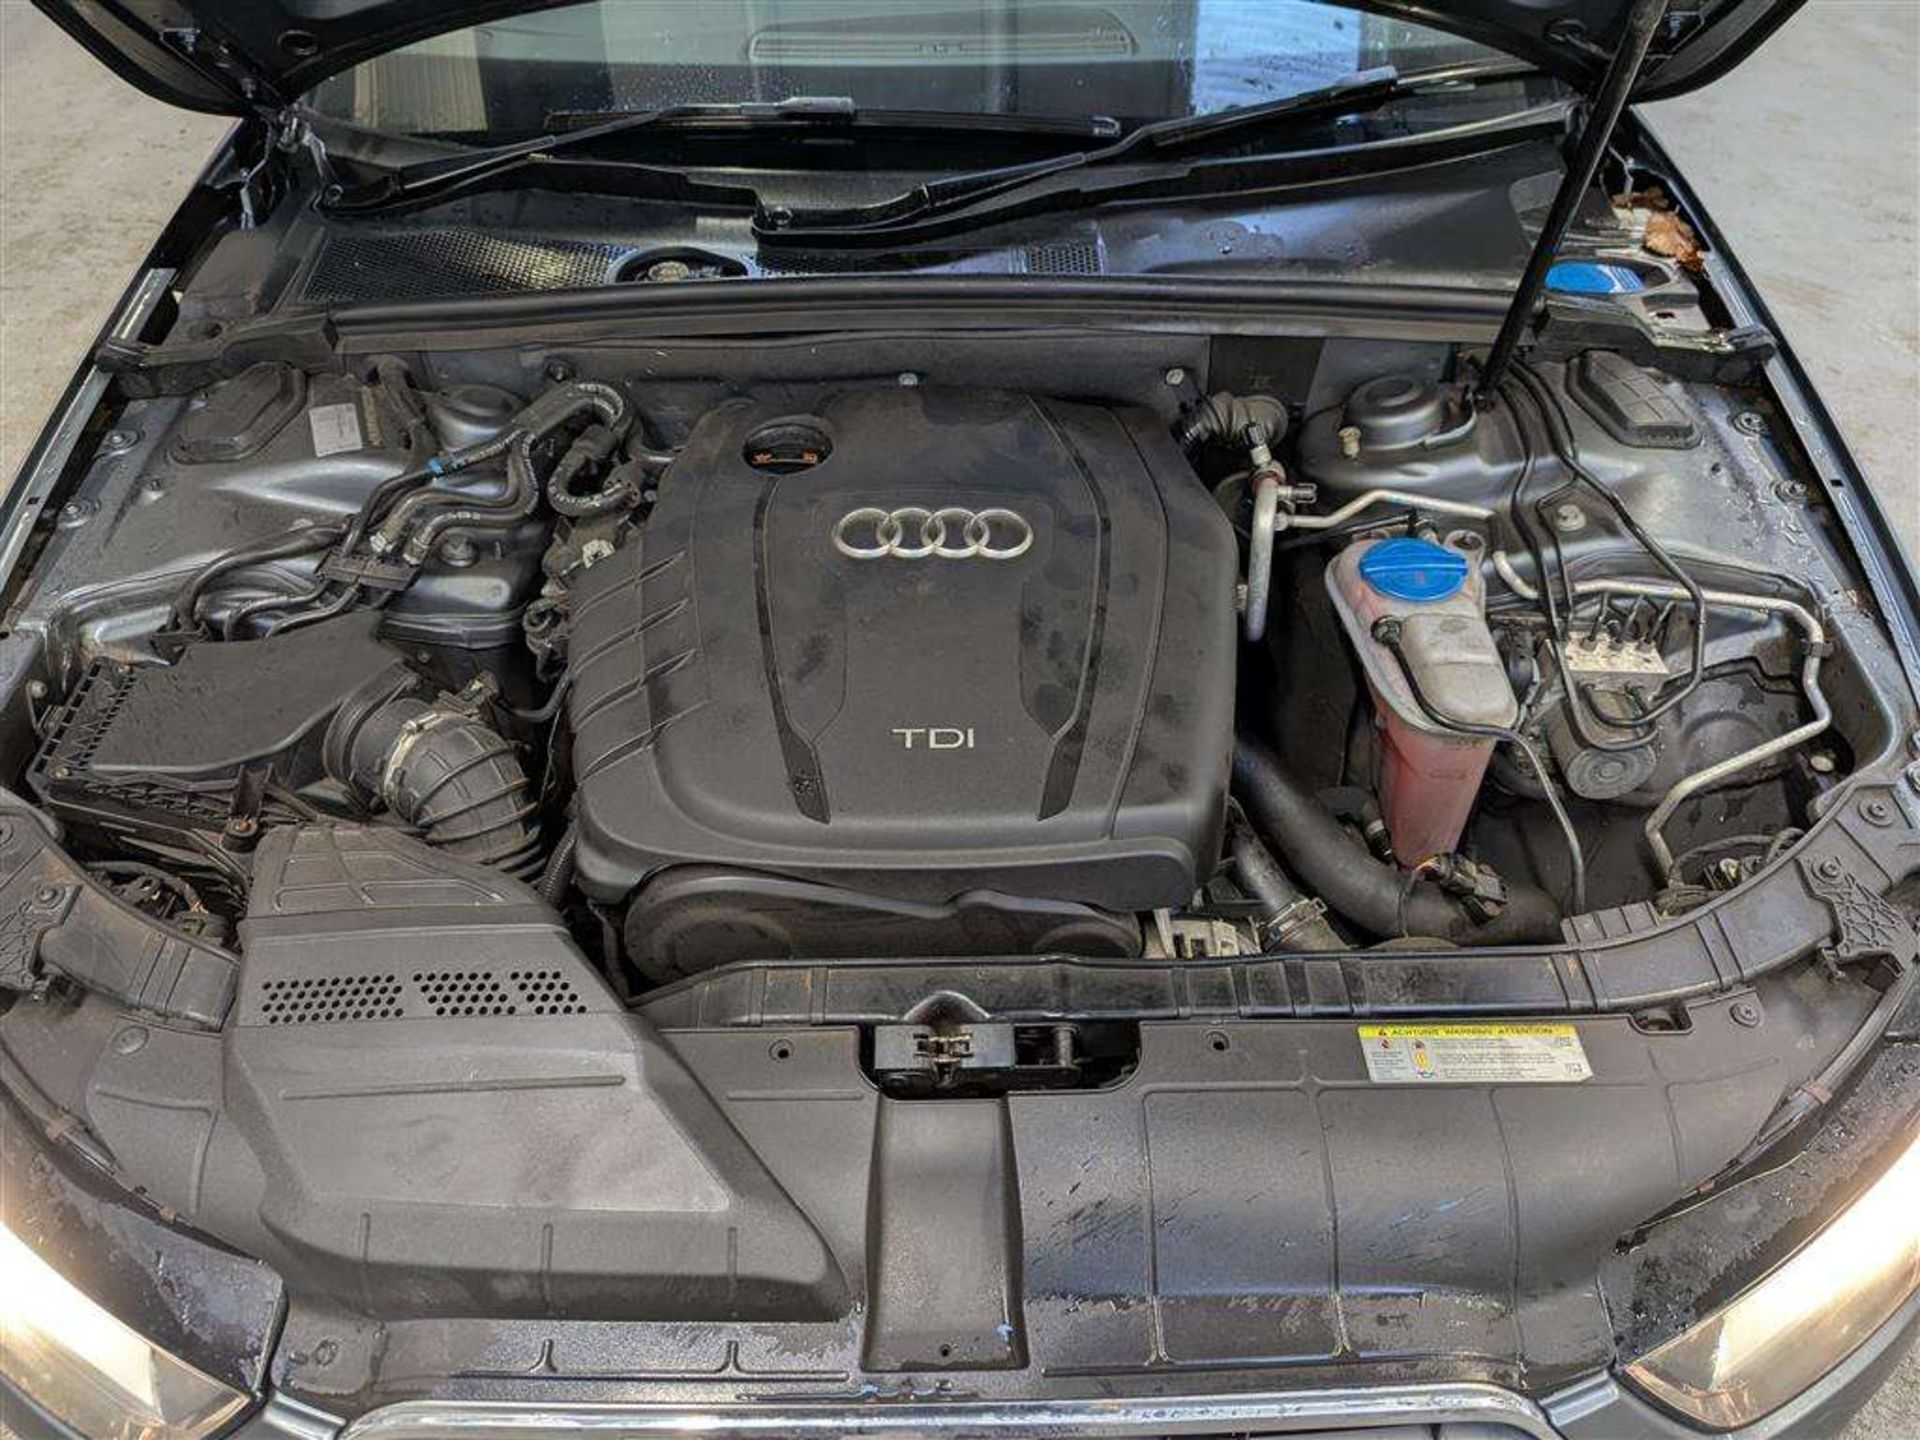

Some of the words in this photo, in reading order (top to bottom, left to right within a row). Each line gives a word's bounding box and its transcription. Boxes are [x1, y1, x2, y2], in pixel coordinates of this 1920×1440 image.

[892, 728, 974, 749] TDI
[1444, 1027, 1493, 1036] WARNING
[1498, 1027, 1554, 1035] ATTENTION
